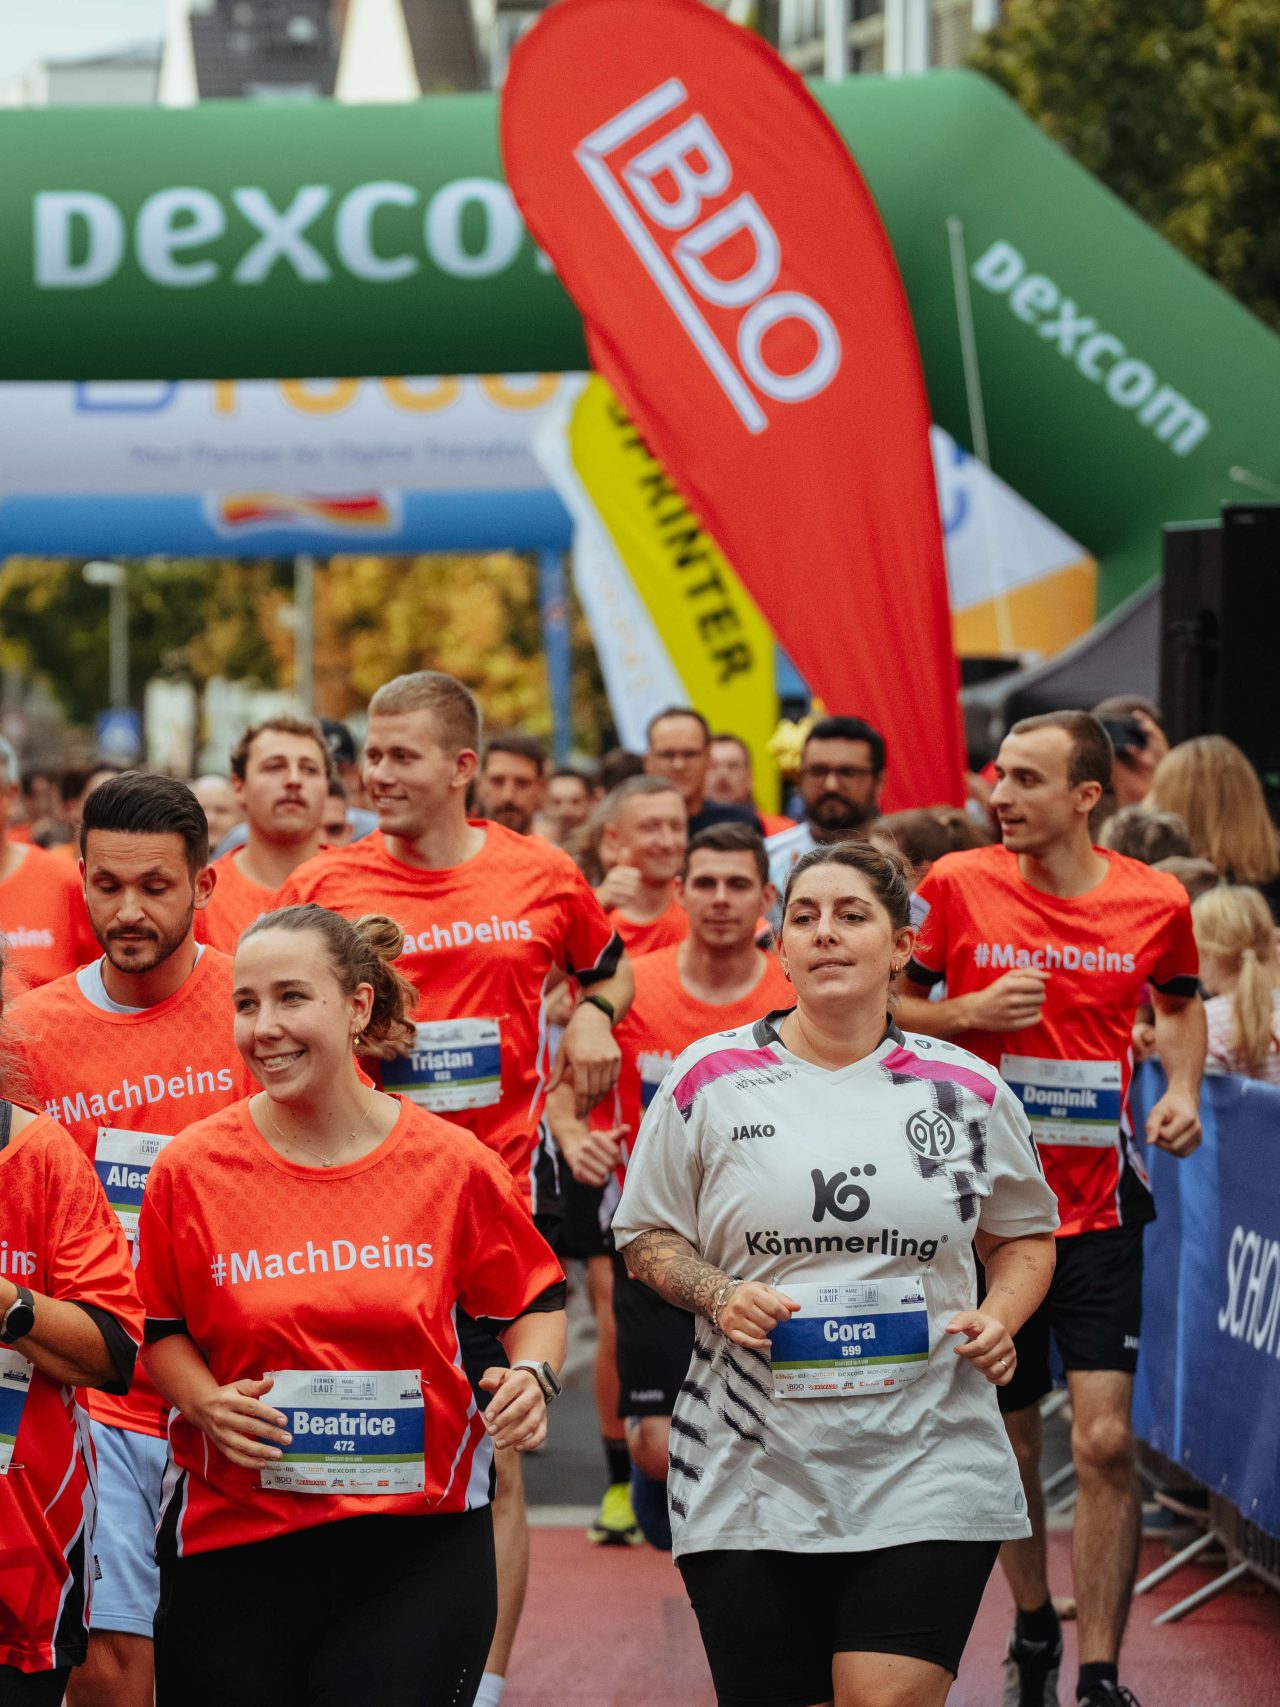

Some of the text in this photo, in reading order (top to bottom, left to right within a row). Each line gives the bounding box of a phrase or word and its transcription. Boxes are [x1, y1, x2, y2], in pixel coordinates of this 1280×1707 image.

[33, 177, 558, 289] Dexco
[622, 112, 841, 404] BDO
[972, 240, 1211, 457] Dexcom
[974, 943, 1136, 973] #MachDeins
[411, 1050, 474, 1072] Tristan
[45, 1066, 233, 1126] #MachDeins
[1023, 1085, 1098, 1108] Dominik
[731, 1124, 776, 1142] JAKO
[210, 1235, 434, 1287] #MachDeins
[819, 1294, 838, 1303] LAUF
[823, 1319, 876, 1342] Cora
[841, 1345, 862, 1356] 599
[313, 1385, 334, 1393] LAUF
[293, 1411, 396, 1436] Beatrice
[333, 1440, 355, 1451] 472
